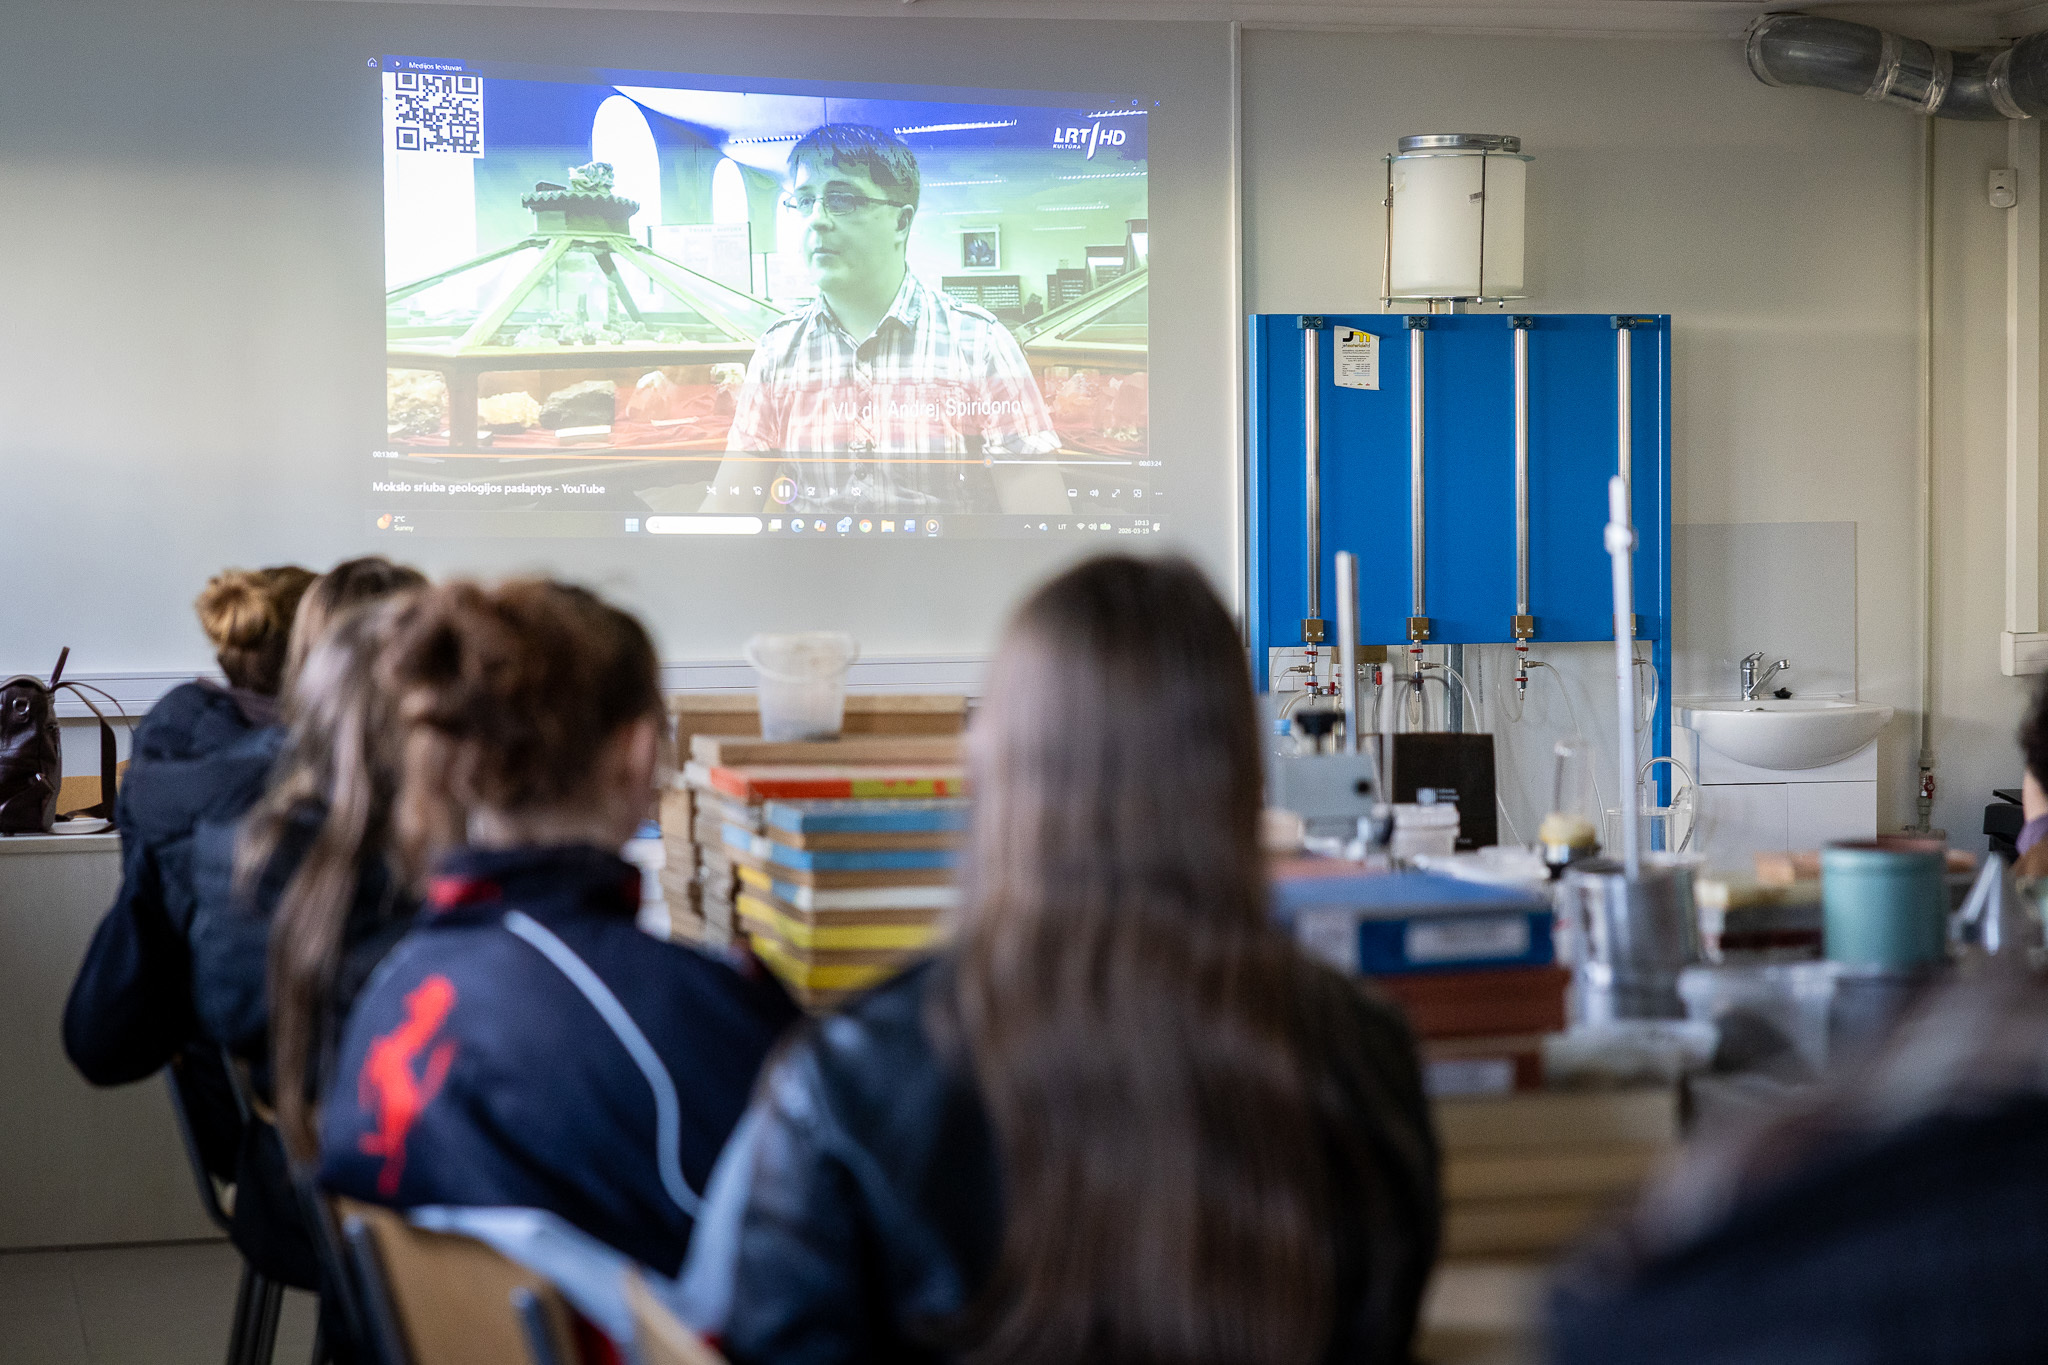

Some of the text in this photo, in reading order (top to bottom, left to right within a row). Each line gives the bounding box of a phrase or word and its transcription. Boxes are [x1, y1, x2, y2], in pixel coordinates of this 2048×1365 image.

[408, 61, 434, 71] Medijos
[1053, 127, 1126, 145] LRT HD
[831, 401, 857, 421] VU
[888, 399, 940, 422] Andrej
[372, 481, 411, 493] Mokslo
[413, 482, 446, 493] sriuba
[448, 483, 502, 495] geologijos
[504, 483, 552, 496] paslaptys
[561, 483, 606, 494] YouTube
